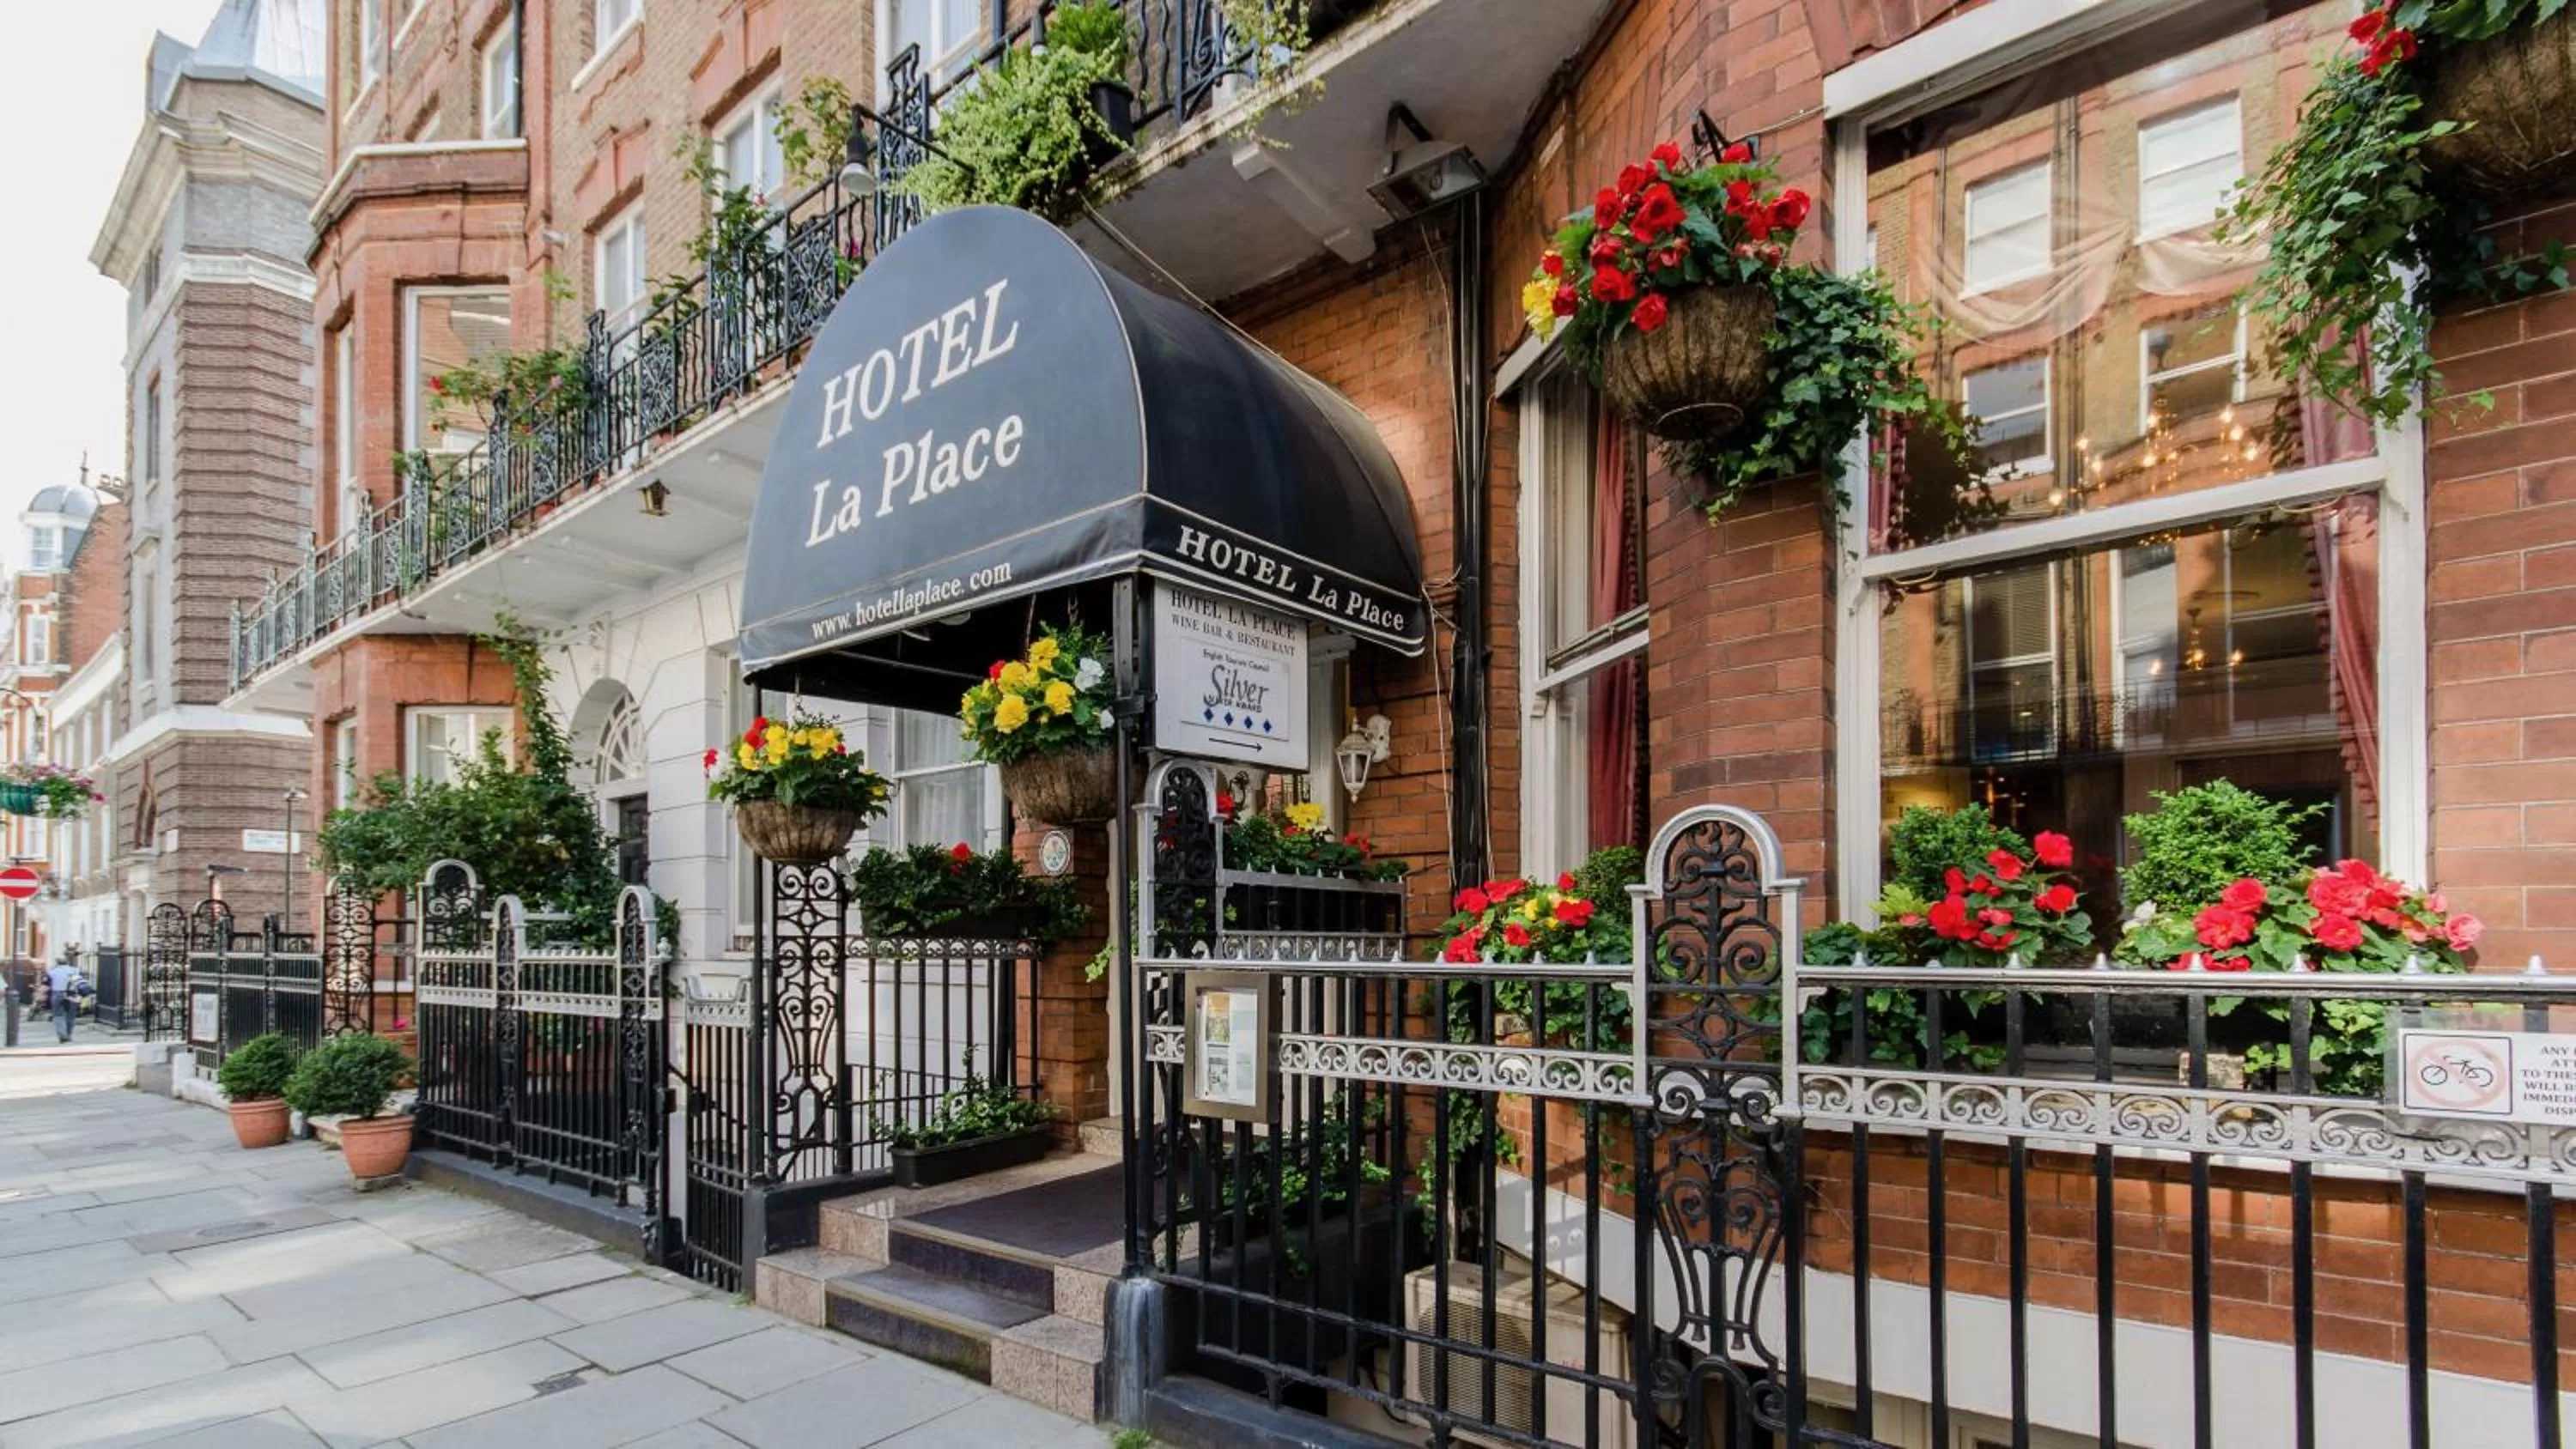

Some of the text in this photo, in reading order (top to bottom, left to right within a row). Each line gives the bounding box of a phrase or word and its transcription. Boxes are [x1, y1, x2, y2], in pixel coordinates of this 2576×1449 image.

[817, 278, 1019, 449] HOTEL
[805, 415, 1024, 549] La Place
[1176, 524, 1405, 632] HOTEL La Place
[1171, 590, 1296, 640] HOTEL LA PLACE
[1171, 614, 1296, 657] WINE BAR & RESTAURANT
[1203, 664, 1270, 707] Silver
[2541, 1046, 2569, 1055] ANY
[2519, 1069, 2542, 1078] TO
[2524, 1082, 2561, 1091] WILL
